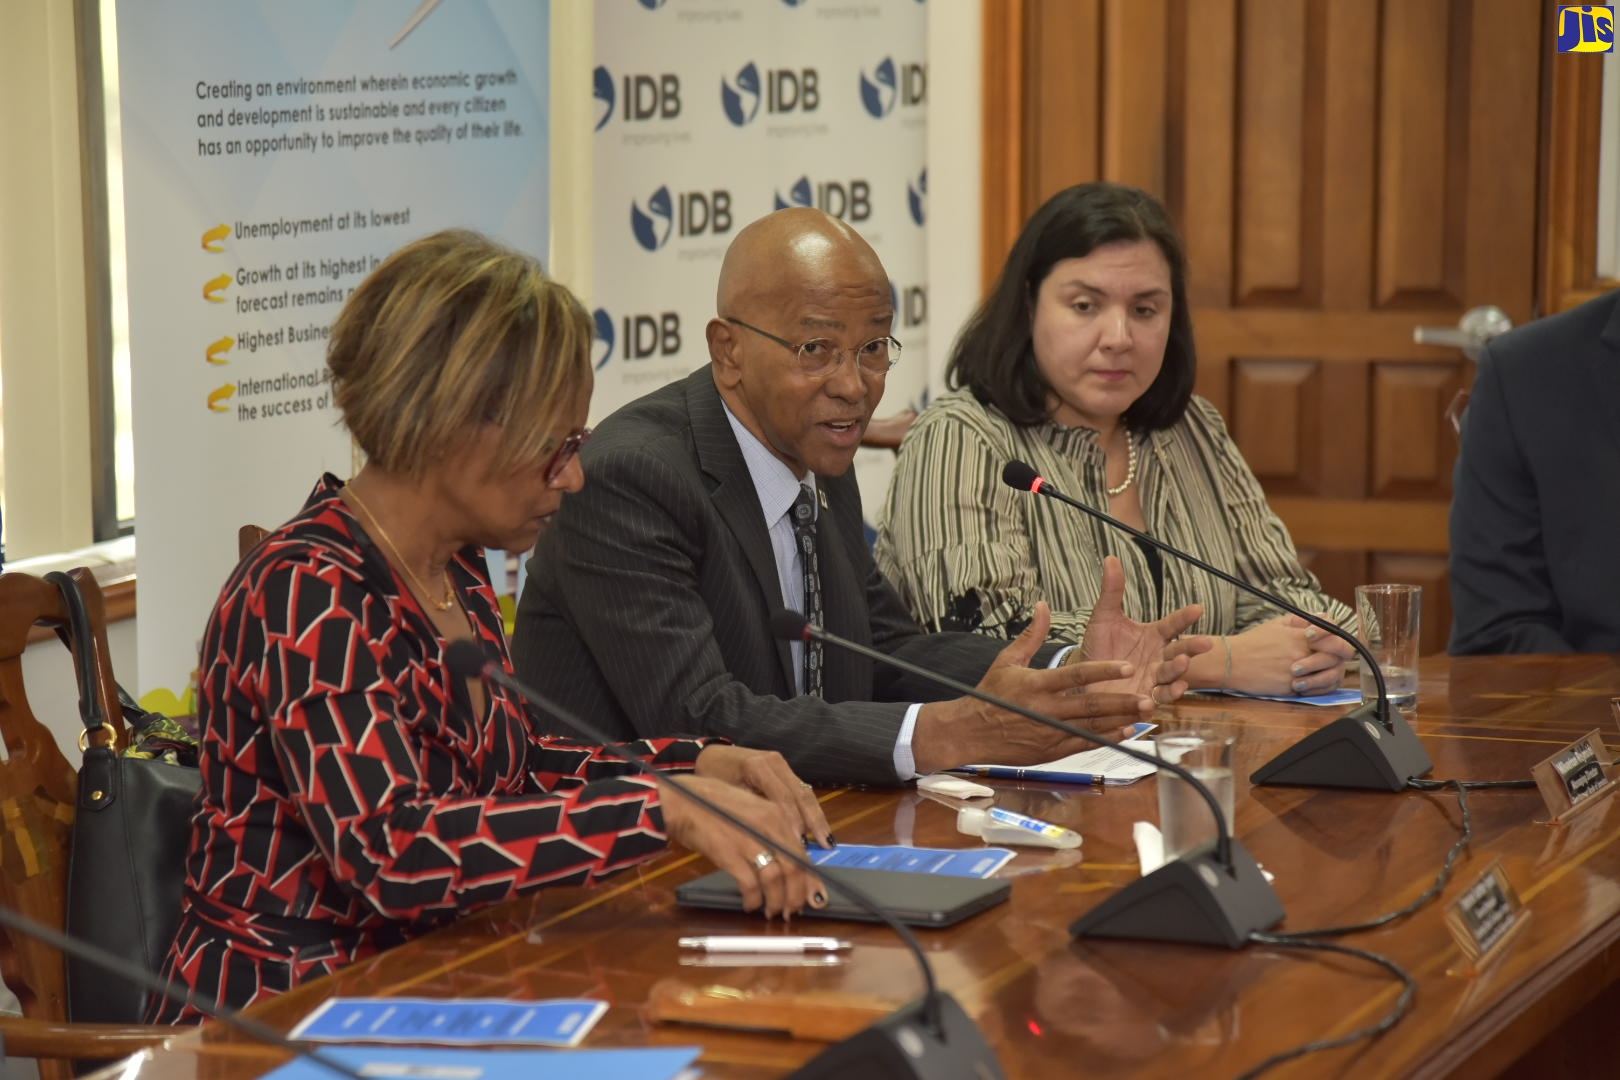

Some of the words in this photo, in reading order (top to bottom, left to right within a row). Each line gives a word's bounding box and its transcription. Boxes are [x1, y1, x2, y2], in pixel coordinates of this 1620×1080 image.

[196, 81, 252, 101] Creating
[257, 85, 272, 97] an
[277, 77, 356, 95] environment
[361, 74, 408, 91] wherein
[412, 71, 470, 89] economic
[475, 70, 517, 90] growth
[623, 74, 681, 121] IDB
[767, 69, 820, 113] IDB
[902, 64, 928, 106] ID
[198, 109, 223, 127] and
[228, 106, 311, 127] development
[316, 105, 324, 120] is
[329, 101, 399, 120] sustainable
[403, 98, 424, 116] and
[429, 100, 459, 116] every
[464, 96, 506, 113] citizen
[198, 139, 221, 156] has
[226, 140, 241, 154] an
[246, 133, 317, 156] opportunity
[322, 133, 333, 147] to
[338, 130, 388, 150] improve
[393, 127, 411, 143] the
[416, 125, 452, 145] quality
[456, 123, 468, 138] of
[472, 122, 499, 138] their
[504, 120, 523, 136] life.
[679, 190, 733, 238] IDB
[818, 180, 871, 223] IDB
[235, 214, 333, 240] Unemployment
[338, 213, 350, 230] at
[354, 211, 367, 228] its
[371, 208, 410, 226] lowest
[236, 264, 282, 286] Growth
[286, 263, 299, 281] at
[303, 261, 316, 279] its
[320, 256, 366, 280] highest
[236, 293, 288, 314] forecast
[292, 286, 343, 306] remains
[903, 287, 928, 328] ID
[237, 328, 284, 352] Highest
[288, 323, 331, 343] Busine
[623, 312, 681, 360] IDB
[237, 369, 319, 397] International
[238, 403, 257, 421] the
[262, 397, 312, 418] success
[316, 392, 329, 408] of
